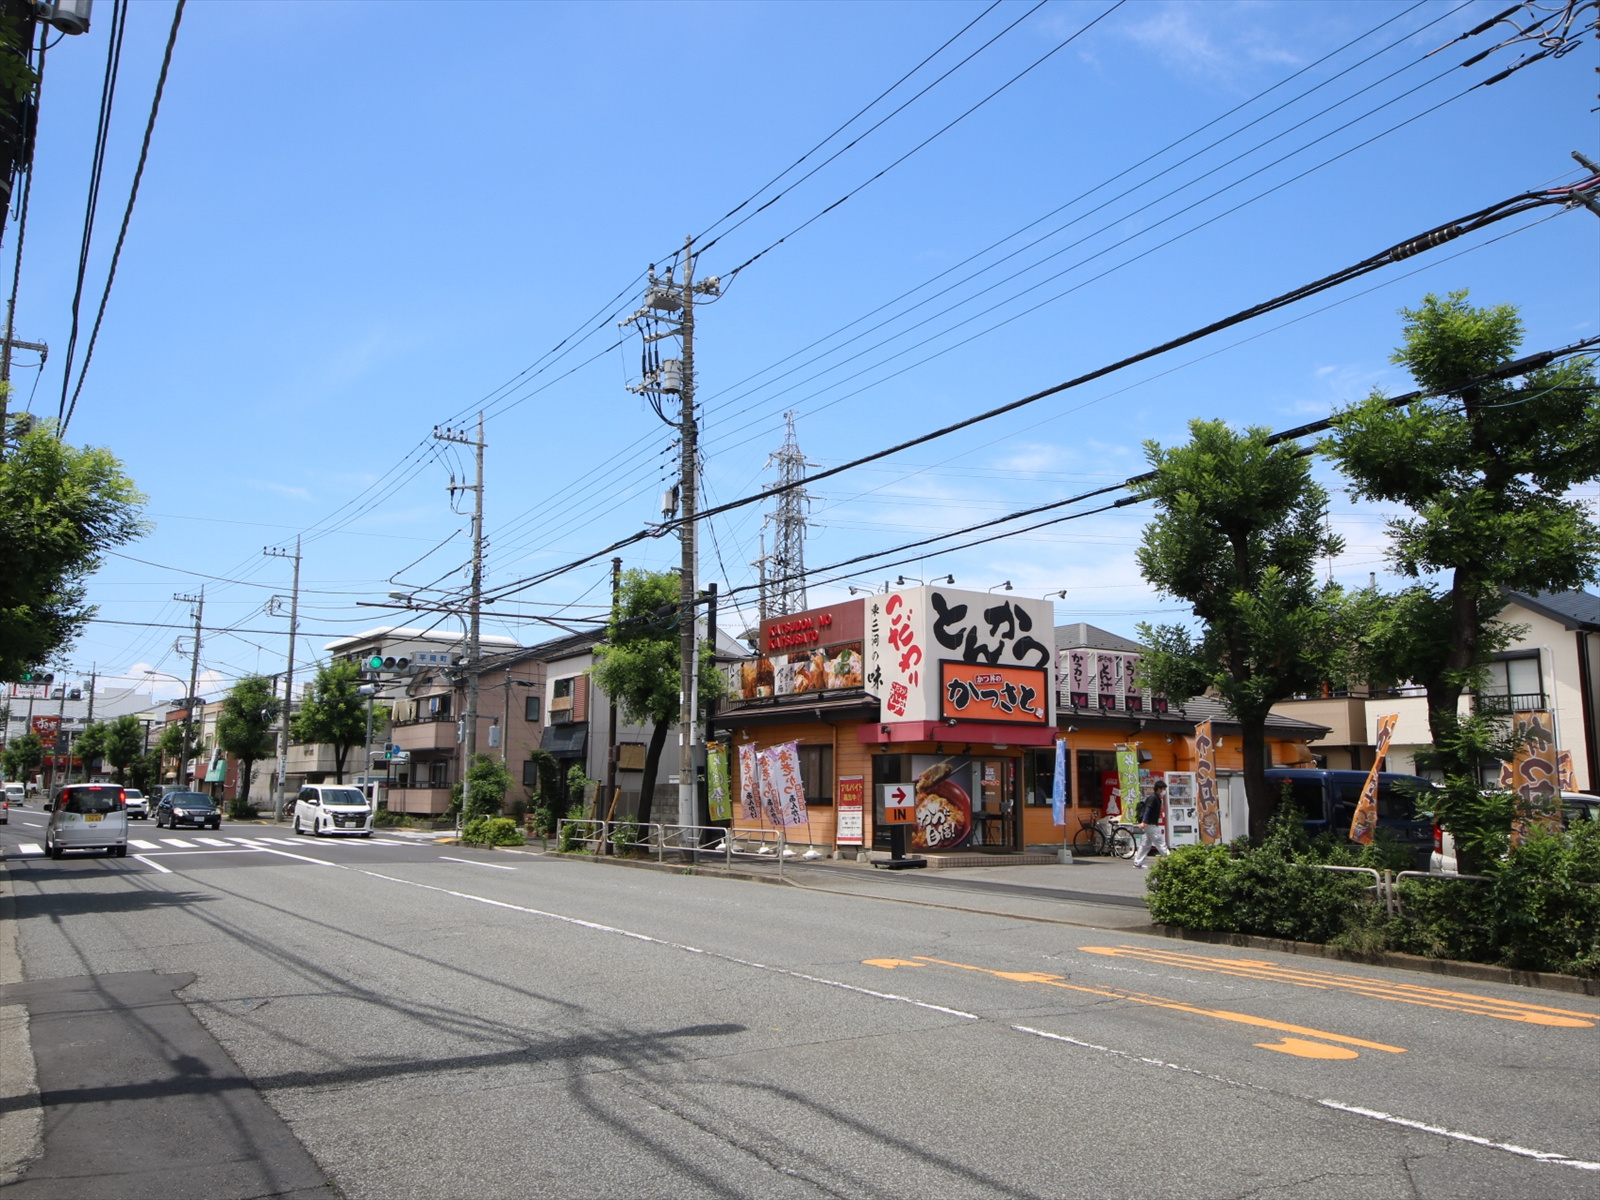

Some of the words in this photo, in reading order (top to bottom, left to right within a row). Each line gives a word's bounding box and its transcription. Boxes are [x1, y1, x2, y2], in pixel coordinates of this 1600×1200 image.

[768, 618, 815, 637] KATSUDON
[817, 613, 832, 627] NO
[768, 629, 819, 649] KATSUSATO
[886, 594, 922, 688] こだわり
[931, 592, 1050, 668] とんかつ
[867, 603, 884, 690] 東三河の味
[1072, 654, 1083, 690] かつカレー
[1100, 663, 1112, 693] とん汁
[947, 679, 1036, 713] かつさと
[893, 809, 907, 820] IN
